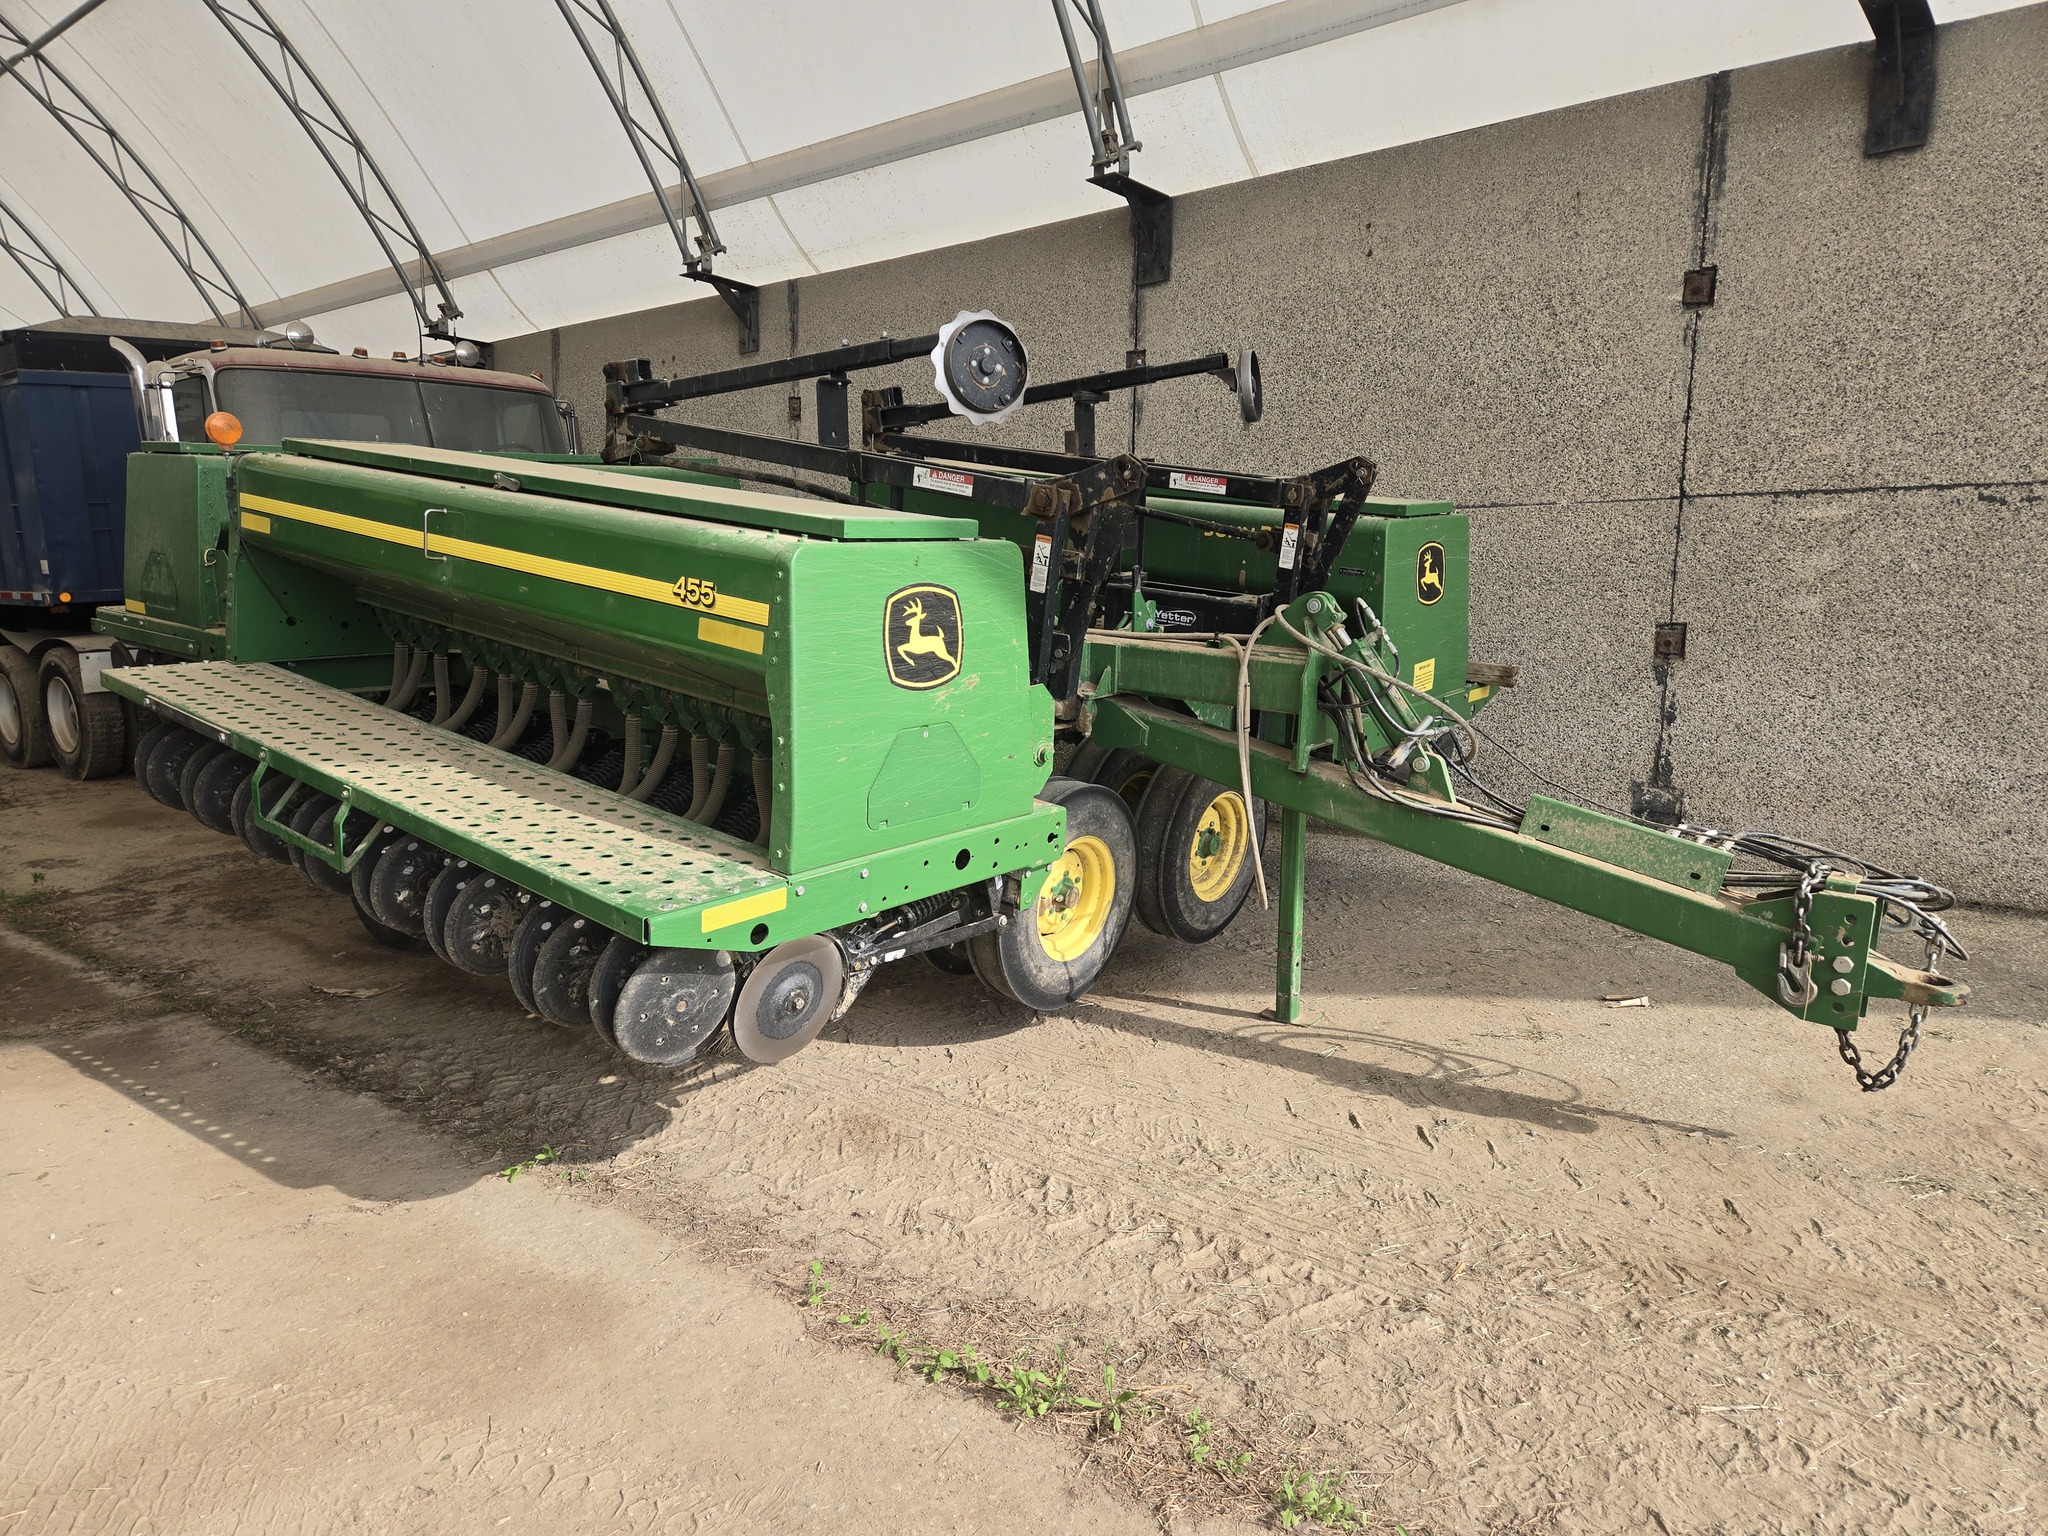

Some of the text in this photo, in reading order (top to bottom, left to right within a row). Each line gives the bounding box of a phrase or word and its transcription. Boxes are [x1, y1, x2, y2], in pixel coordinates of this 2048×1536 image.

[938, 471, 965, 483] DANGER
[1193, 475, 1219, 484] DANGER
[672, 575, 717, 610] 455
[1155, 610, 1194, 623] Yetter
